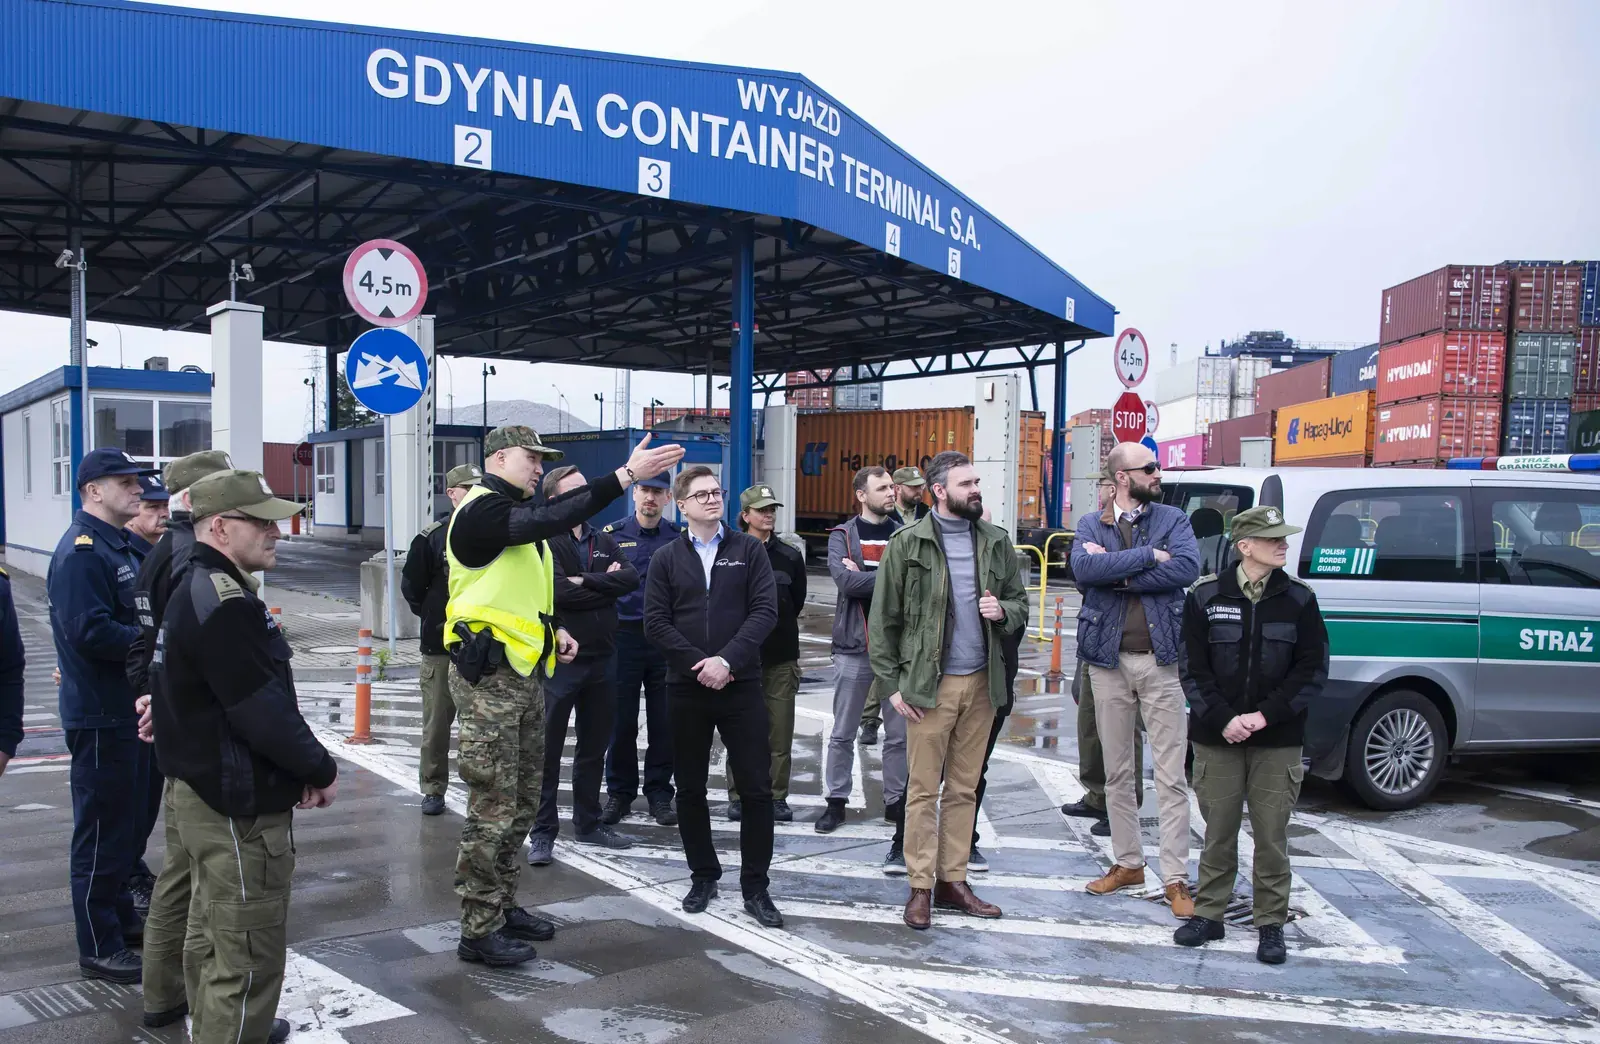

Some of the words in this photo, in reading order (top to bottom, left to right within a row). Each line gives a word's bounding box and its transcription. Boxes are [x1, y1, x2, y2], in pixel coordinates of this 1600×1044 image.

[736, 78, 841, 137] WYJAZD
[366, 48, 583, 132] GDYNIA
[595, 92, 835, 187] CONTAINER
[840, 152, 946, 236] TERMINAL
[949, 206, 981, 251] S.A.
[463, 131, 483, 166] 2
[646, 162, 664, 193] 3
[889, 224, 898, 252] 4
[950, 251, 959, 275] 5
[1453, 279, 1470, 289] tex
[1358, 364, 1377, 382] CMA
[1386, 359, 1432, 383] HYUNDAI
[1115, 410, 1144, 430] STOP
[1303, 413, 1354, 442] Hapag-Lloyd
[1386, 422, 1432, 443] HYUNDAI
[298, 450, 312, 459] STO
[1168, 443, 1187, 467] ONE
[1318, 556, 1347, 564] BORDER
[1320, 548, 1346, 556] POLISH
[1519, 626, 1594, 653] STRAŻ
